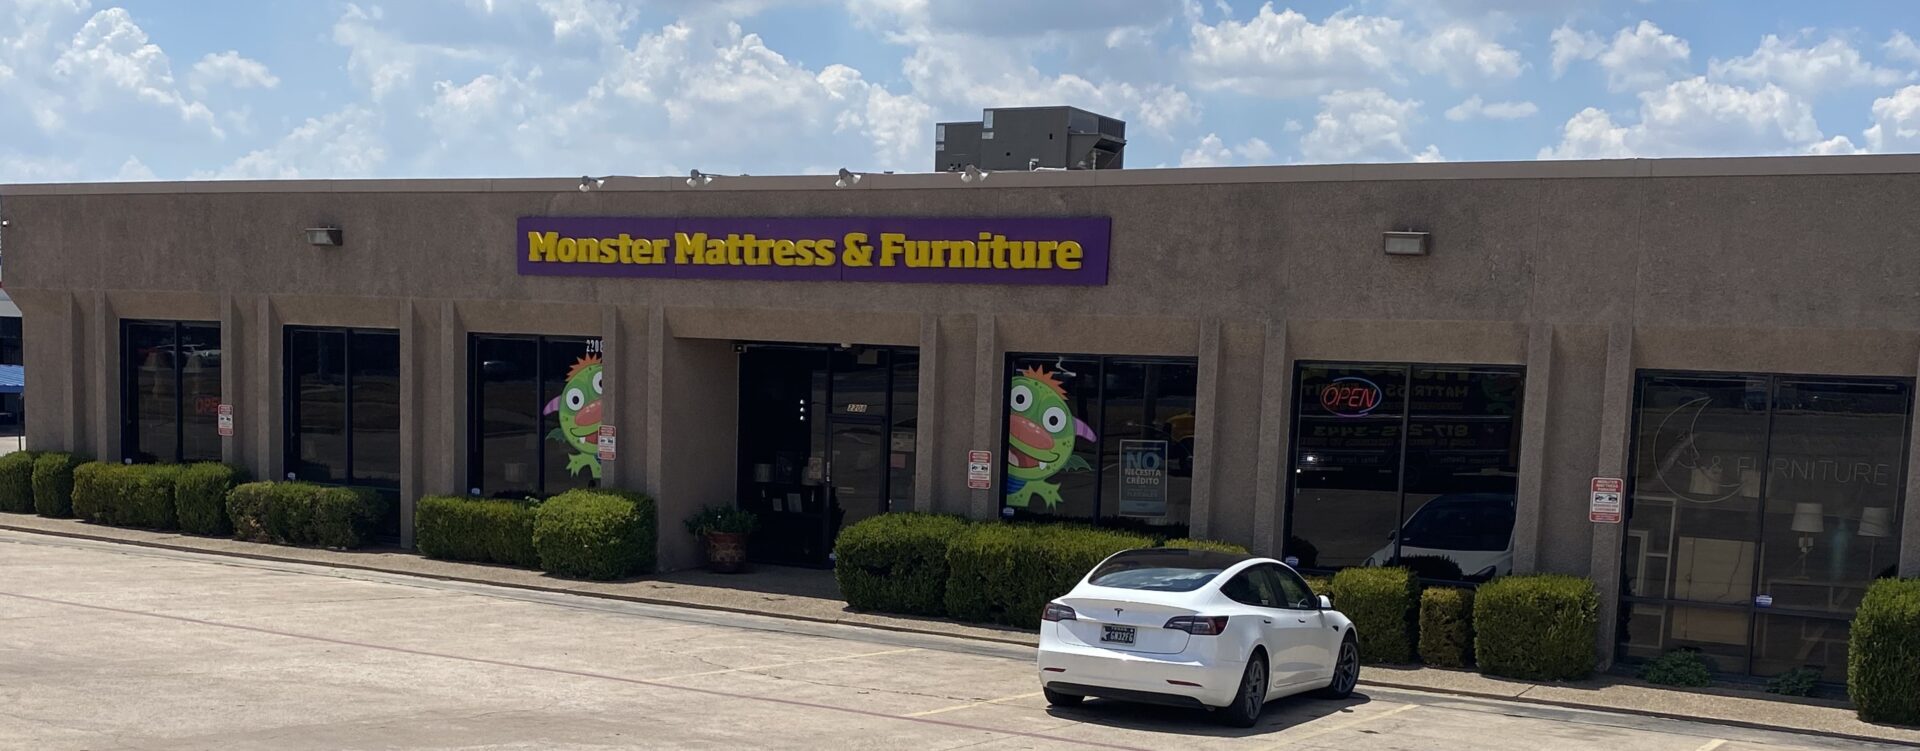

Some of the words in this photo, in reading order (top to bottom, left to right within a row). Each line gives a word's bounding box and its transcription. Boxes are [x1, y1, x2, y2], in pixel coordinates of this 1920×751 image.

[528, 231, 670, 265] Monster
[674, 232, 837, 267] Mattress
[842, 232, 874, 268] &
[879, 231, 1085, 270] Furniture
[1323, 386, 1377, 408] OPEN
[1126, 451, 1160, 470] NO
[1124, 467, 1162, 477] NECESITA
[1126, 475, 1160, 485] CRÉDITO
